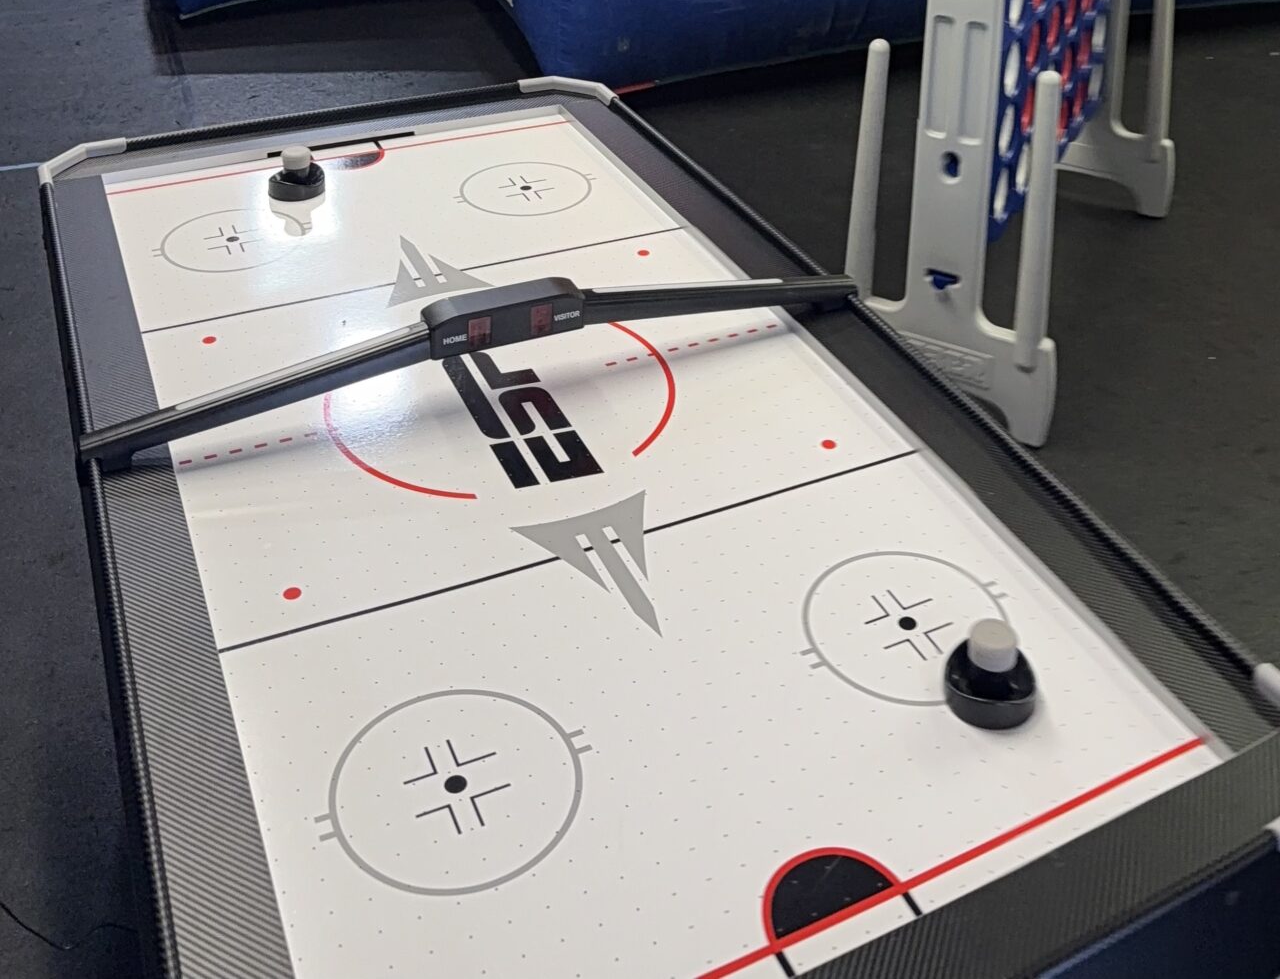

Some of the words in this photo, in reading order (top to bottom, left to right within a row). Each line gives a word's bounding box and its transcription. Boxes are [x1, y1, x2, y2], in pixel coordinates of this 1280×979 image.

[554, 310, 580, 322] VISITOR
[443, 334, 467, 345] HOME
[442, 349, 604, 489] ESP
